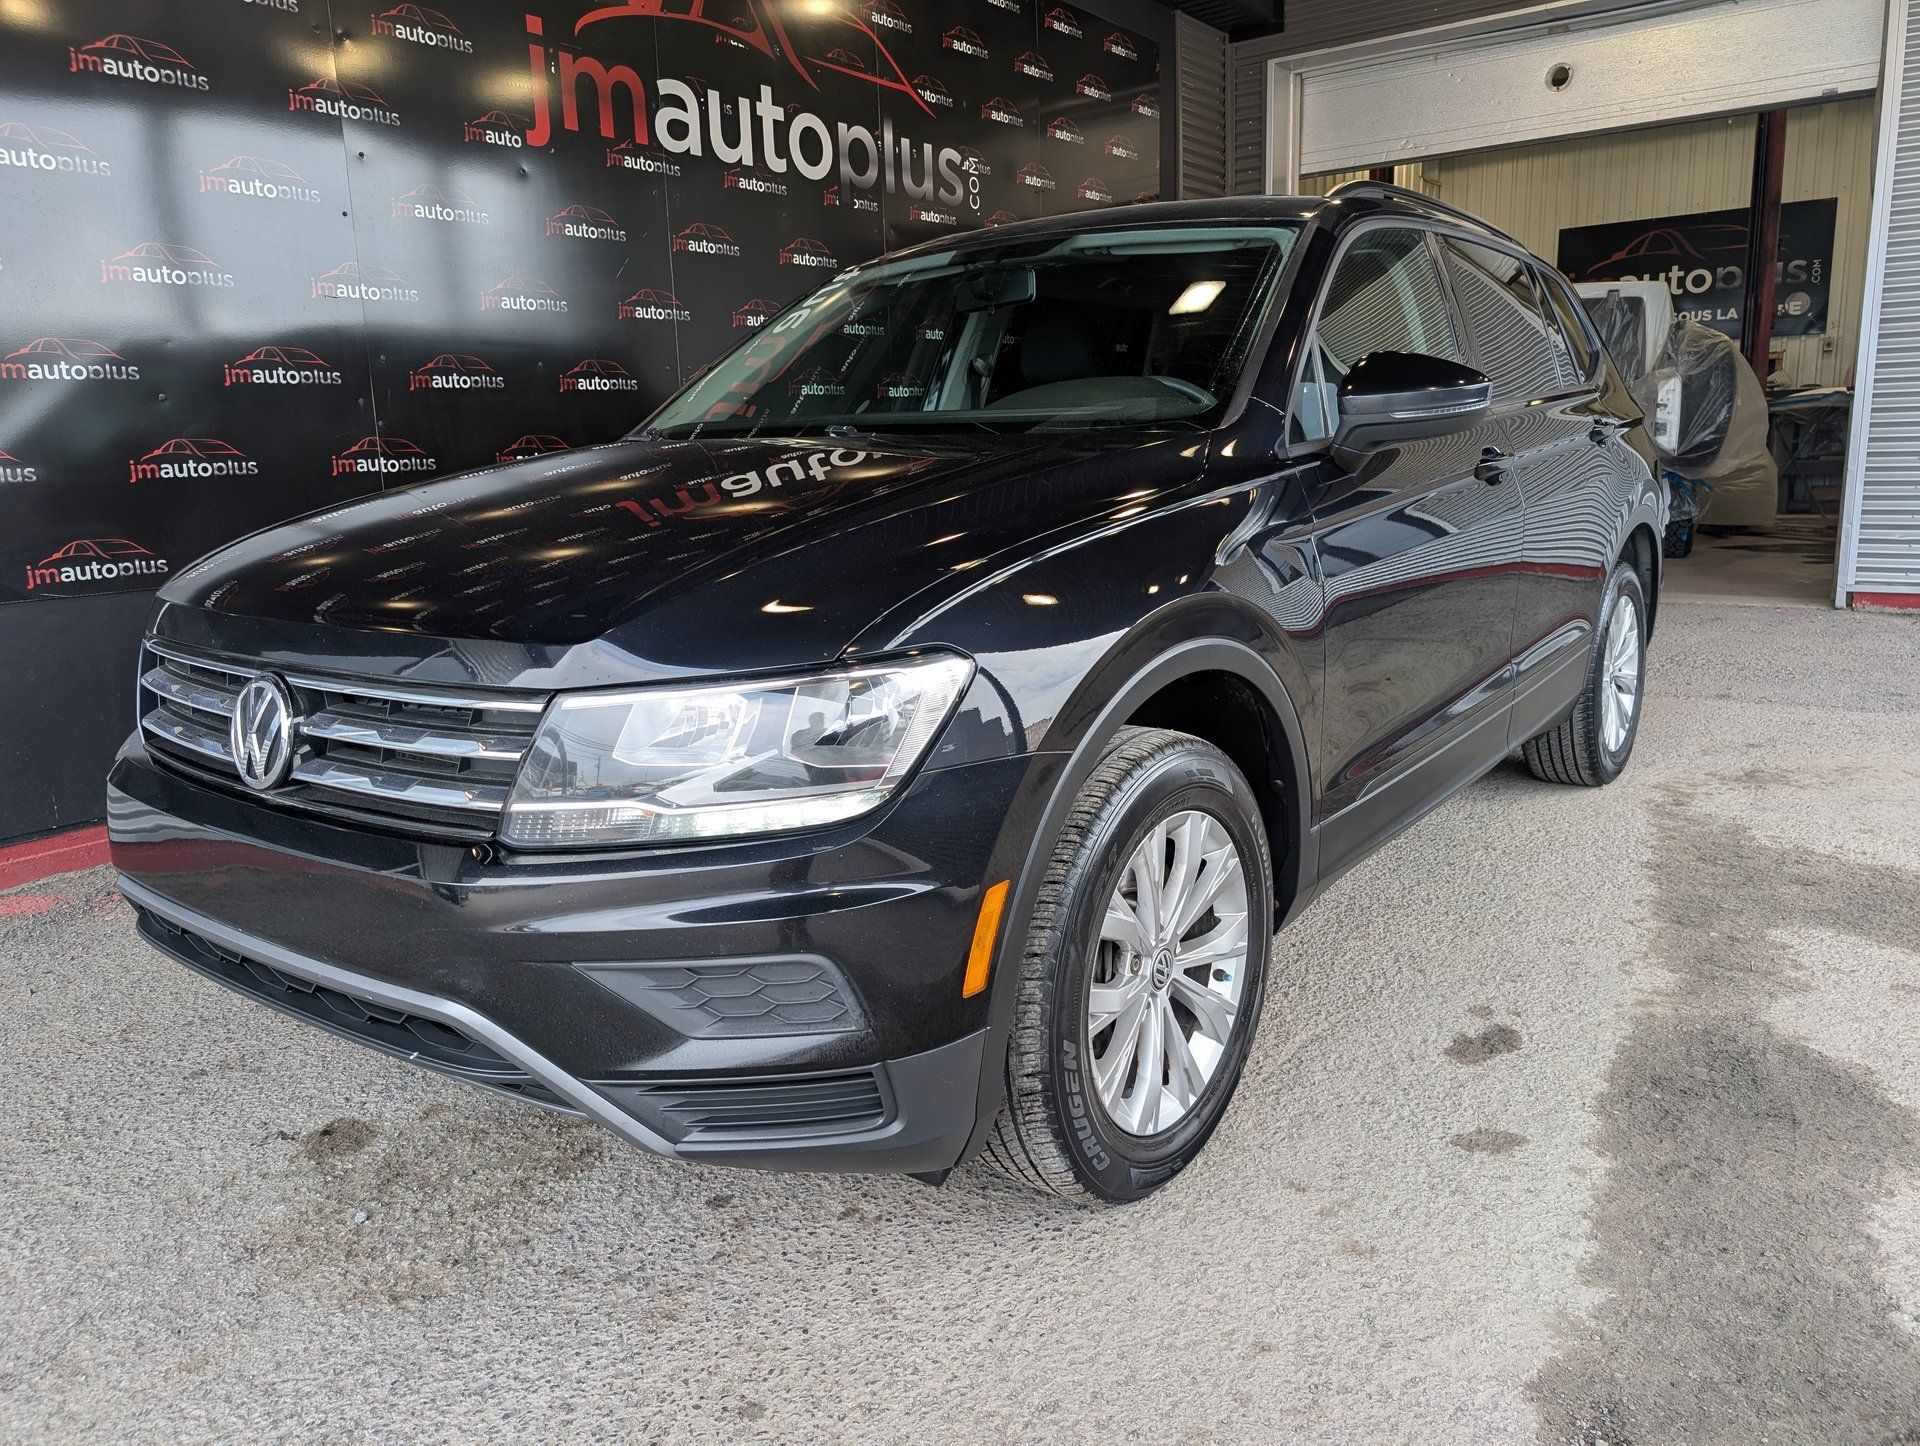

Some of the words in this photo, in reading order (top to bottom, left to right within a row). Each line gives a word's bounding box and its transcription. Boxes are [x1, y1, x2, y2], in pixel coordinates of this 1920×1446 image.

[859, 3, 912, 34] jmautoplus
[371, 13, 473, 54] jmautoplus
[942, 34, 989, 60] jmautoplus
[68, 46, 209, 91] jmautoplus
[288, 88, 400, 126] jmautoplus
[525, 14, 964, 207] jmautoplus
[606, 148, 681, 177] jmautoplus
[199, 170, 321, 203] jmautoplus
[724, 172, 787, 197] jmautoplus
[545, 217, 626, 242] jmautoplus
[672, 234, 740, 257] jmautoplus
[779, 248, 838, 269] jmautoplus
[101, 260, 234, 288] jmautoplus
[310, 276, 419, 302] jmautoplus
[480, 291, 568, 313] jmautoplus
[618, 302, 691, 321] jmautoplus
[0, 361, 140, 382] mautoplus
[224, 364, 342, 386] jmautoplus
[409, 371, 505, 391] jmautoplus
[559, 374, 638, 393] jmautoplus
[129, 459, 258, 483] jmautoplus
[332, 453, 436, 477] jmautoplus
[26, 559, 169, 589] jmautoplus
[1063, 1040, 1110, 1170] CRUGEN
